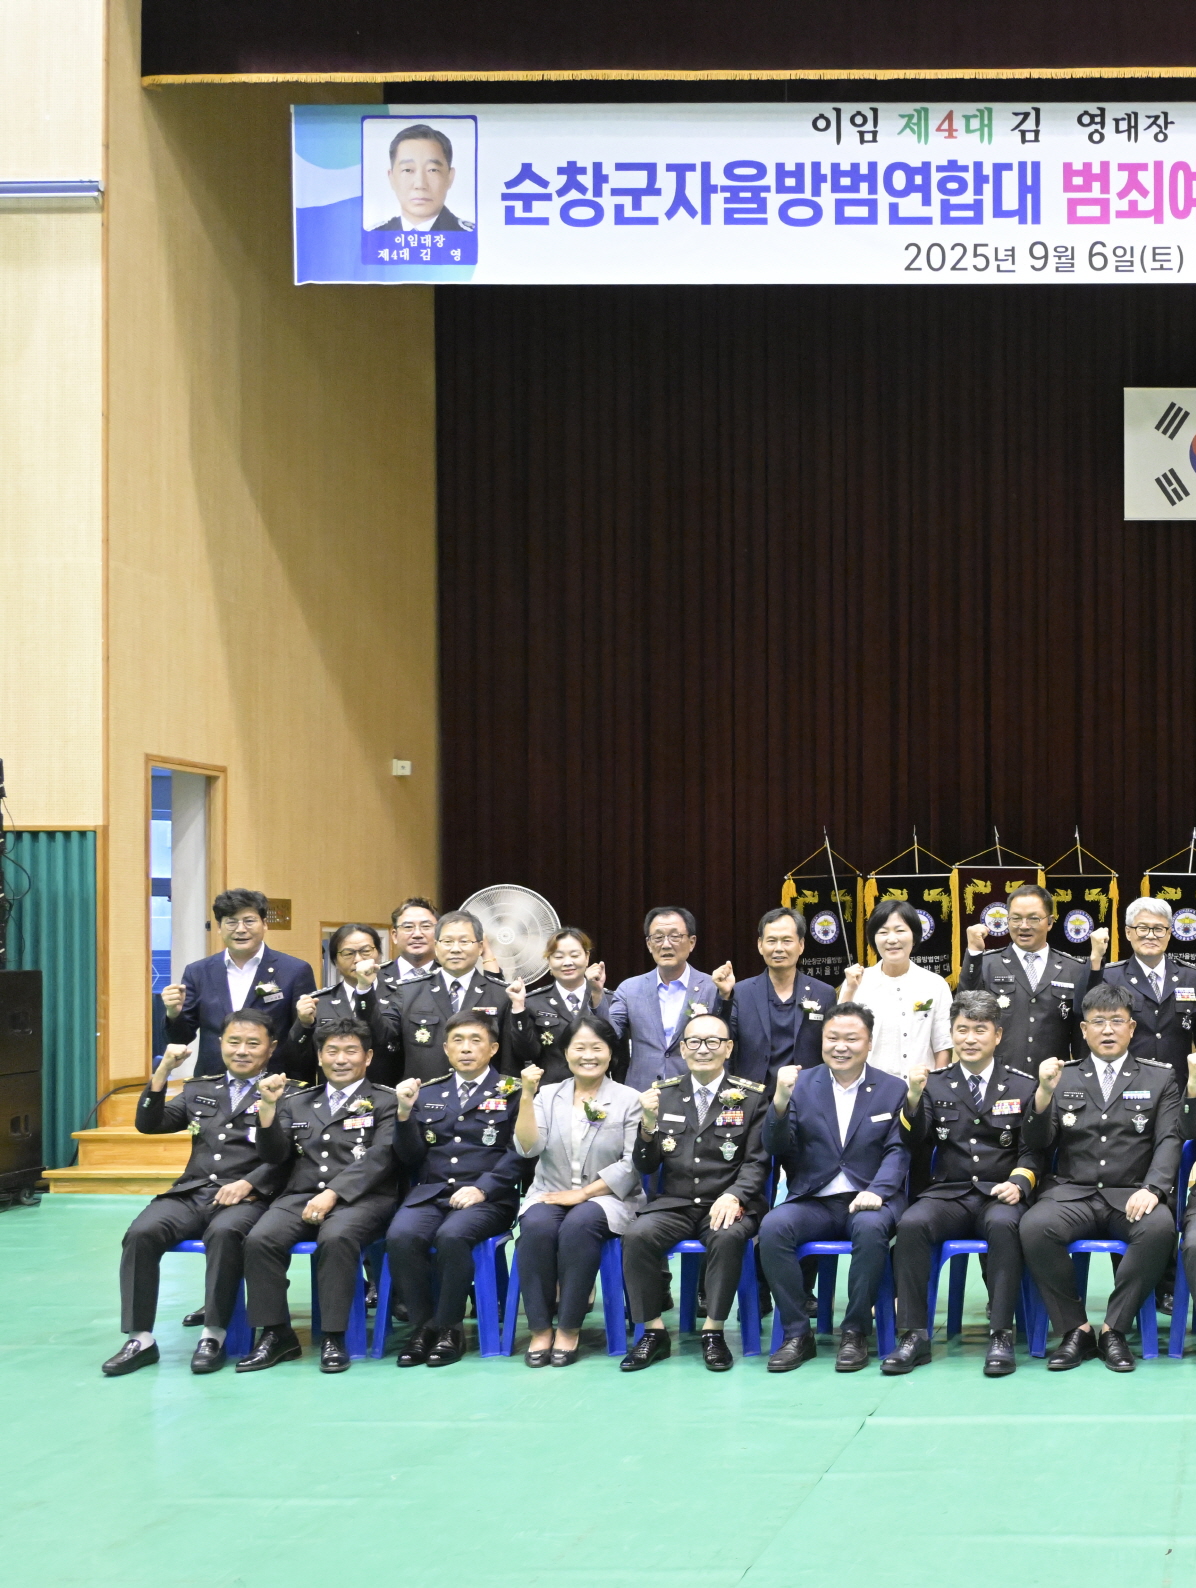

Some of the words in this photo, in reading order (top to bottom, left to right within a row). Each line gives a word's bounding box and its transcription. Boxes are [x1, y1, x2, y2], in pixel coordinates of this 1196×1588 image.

[811, 106, 880, 146] 이임
[897, 106, 994, 146] 제4대
[1009, 107, 1042, 146] 김
[500, 158, 1042, 228] 순창군자율방범연합대
[377, 248, 410, 262] 제4대
[419, 248, 431, 261] 김
[449, 248, 461, 262] 영
[394, 233, 446, 248] 이임대장
[903, 242, 1017, 274] 2025년
[1028, 240, 1076, 273] 9월
[1087, 240, 1185, 275] 6일(토)
